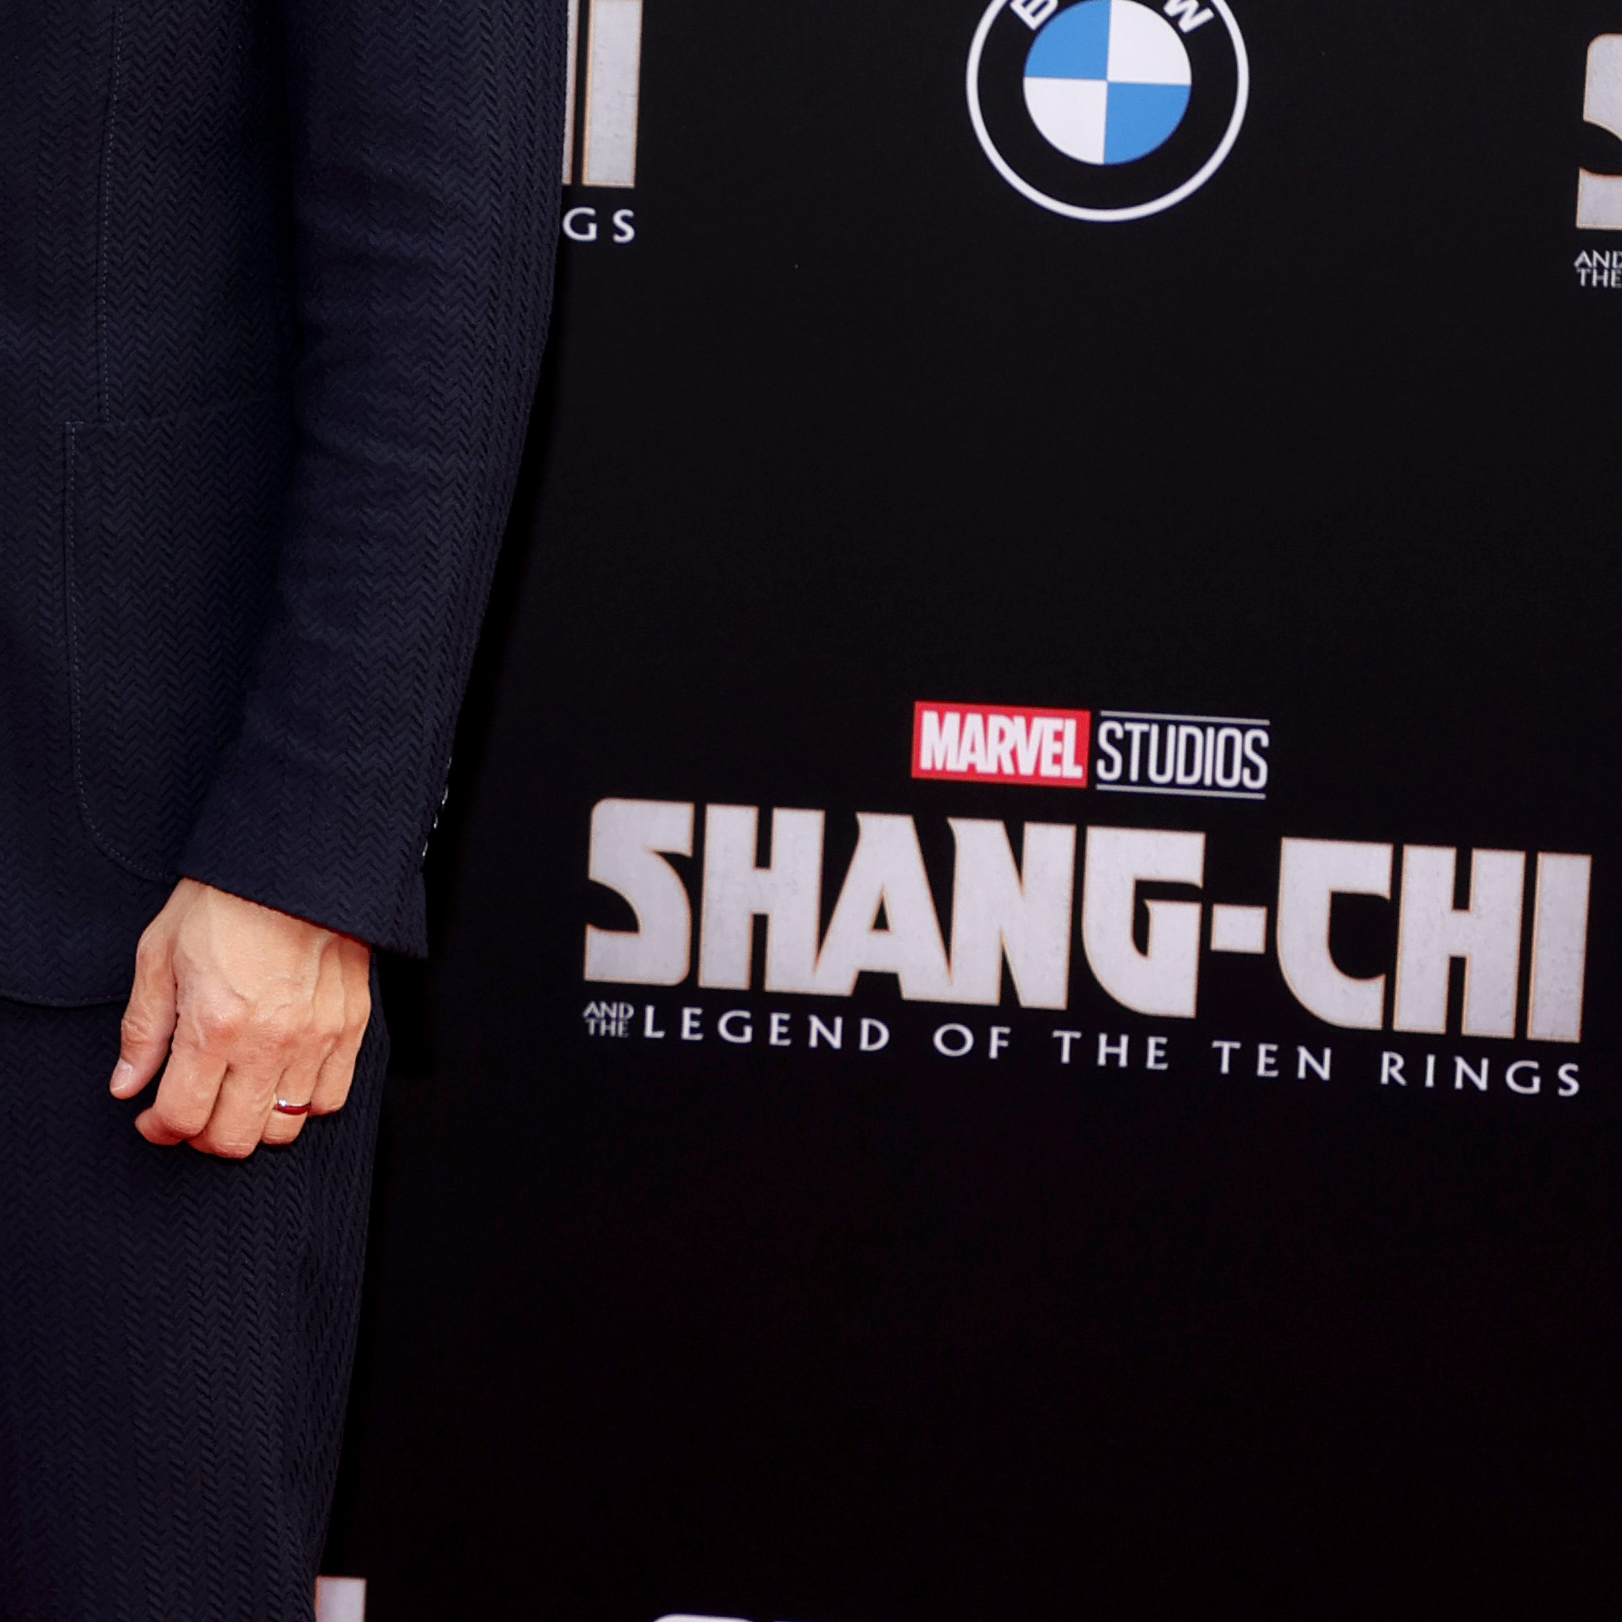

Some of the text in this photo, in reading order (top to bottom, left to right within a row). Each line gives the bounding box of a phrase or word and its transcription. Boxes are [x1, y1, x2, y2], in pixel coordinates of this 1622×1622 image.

[919, 709, 1270, 789] MARVEL STUDIOS
[584, 798, 1591, 1043] SHANG-CHI
[583, 1001, 635, 1020] AND
[586, 1018, 629, 1038] THE
[644, 1005, 1580, 1097] LEGEND OF THE TEN RINGS
